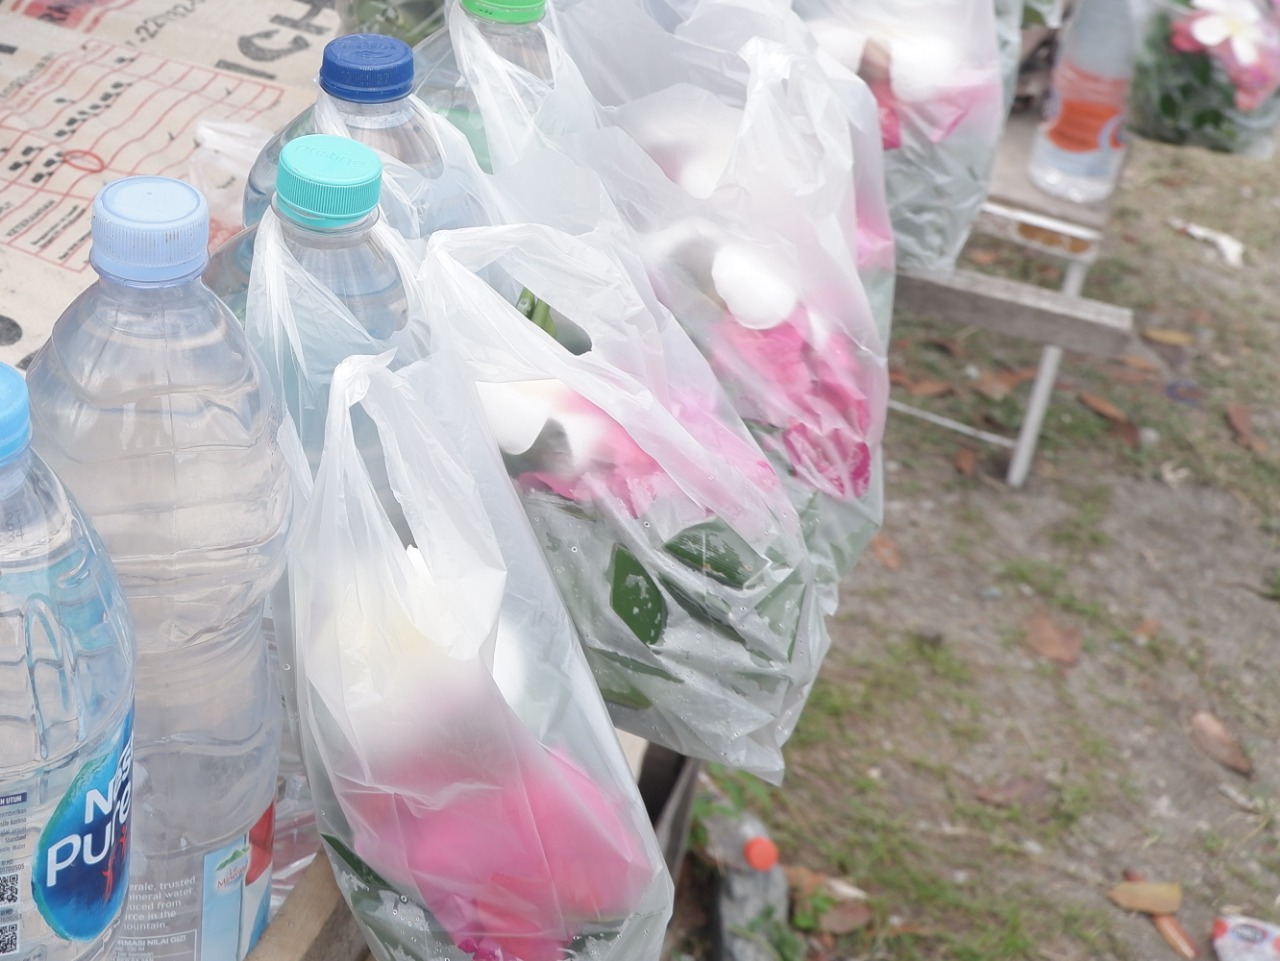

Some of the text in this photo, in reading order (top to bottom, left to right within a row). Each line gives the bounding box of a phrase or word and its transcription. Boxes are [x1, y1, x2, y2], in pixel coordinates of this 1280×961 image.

[159, 875, 196, 891] trusted
[164, 887, 193, 900] water
[156, 899, 182, 910] from
[147, 912, 158, 920] in
[159, 909, 177, 919] the
[147, 937, 169, 947] NILAI
